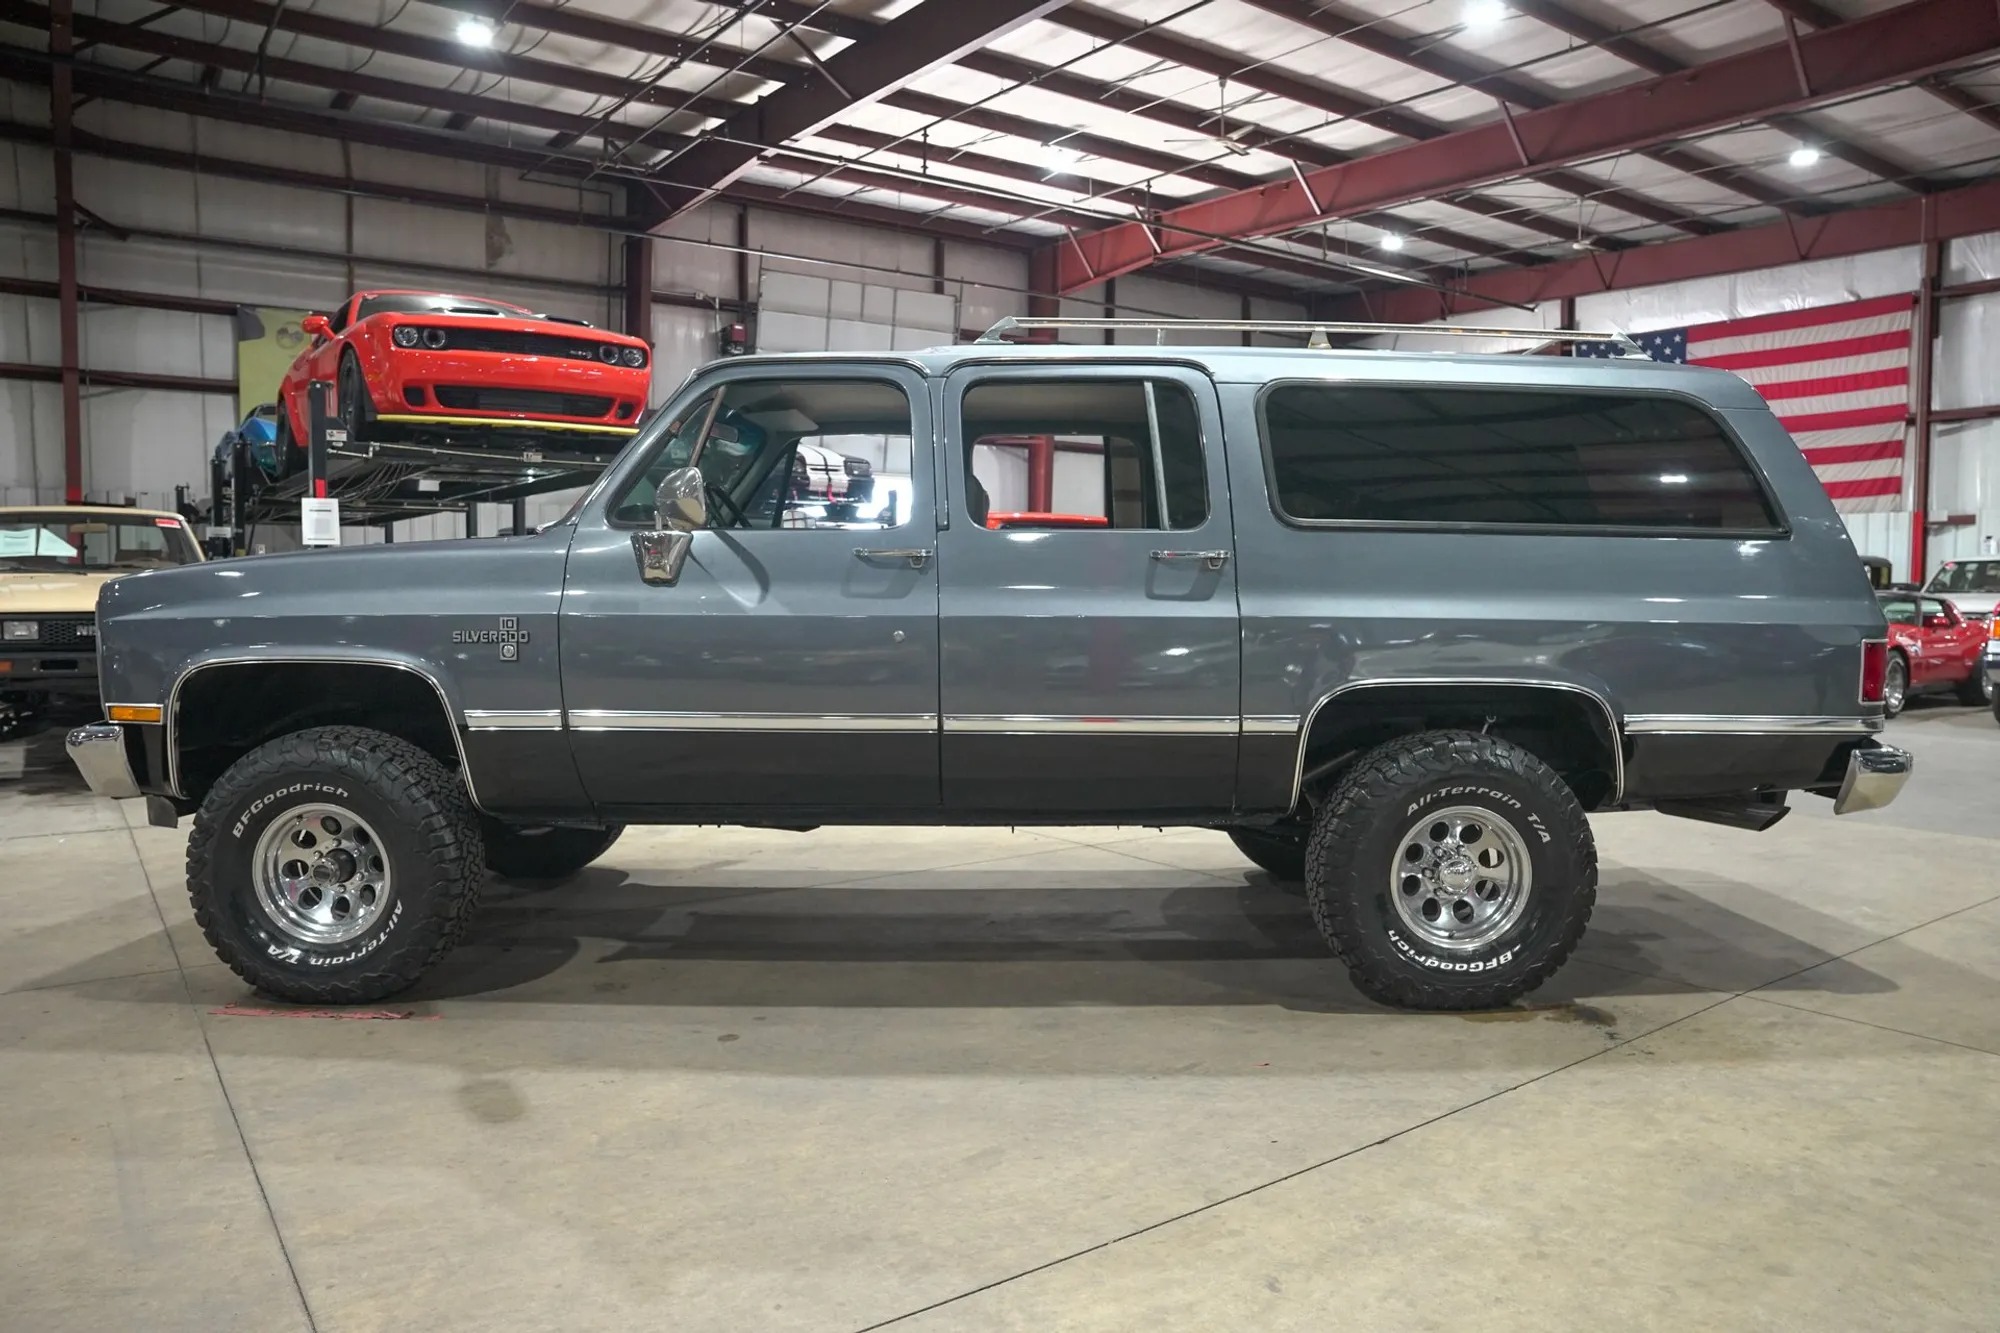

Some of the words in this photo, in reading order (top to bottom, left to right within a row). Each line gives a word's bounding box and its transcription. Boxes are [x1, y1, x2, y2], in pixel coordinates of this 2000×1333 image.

[452, 630, 529, 643] SILVERADO
[502, 619, 514, 629] 10
[232, 782, 349, 838] BFGoodrich
[1407, 786, 1521, 816] All-Terrain
[1527, 813, 1551, 843] T/A
[310, 899, 402, 967] All-Terrain
[1388, 930, 1513, 972] BFGoodrich
